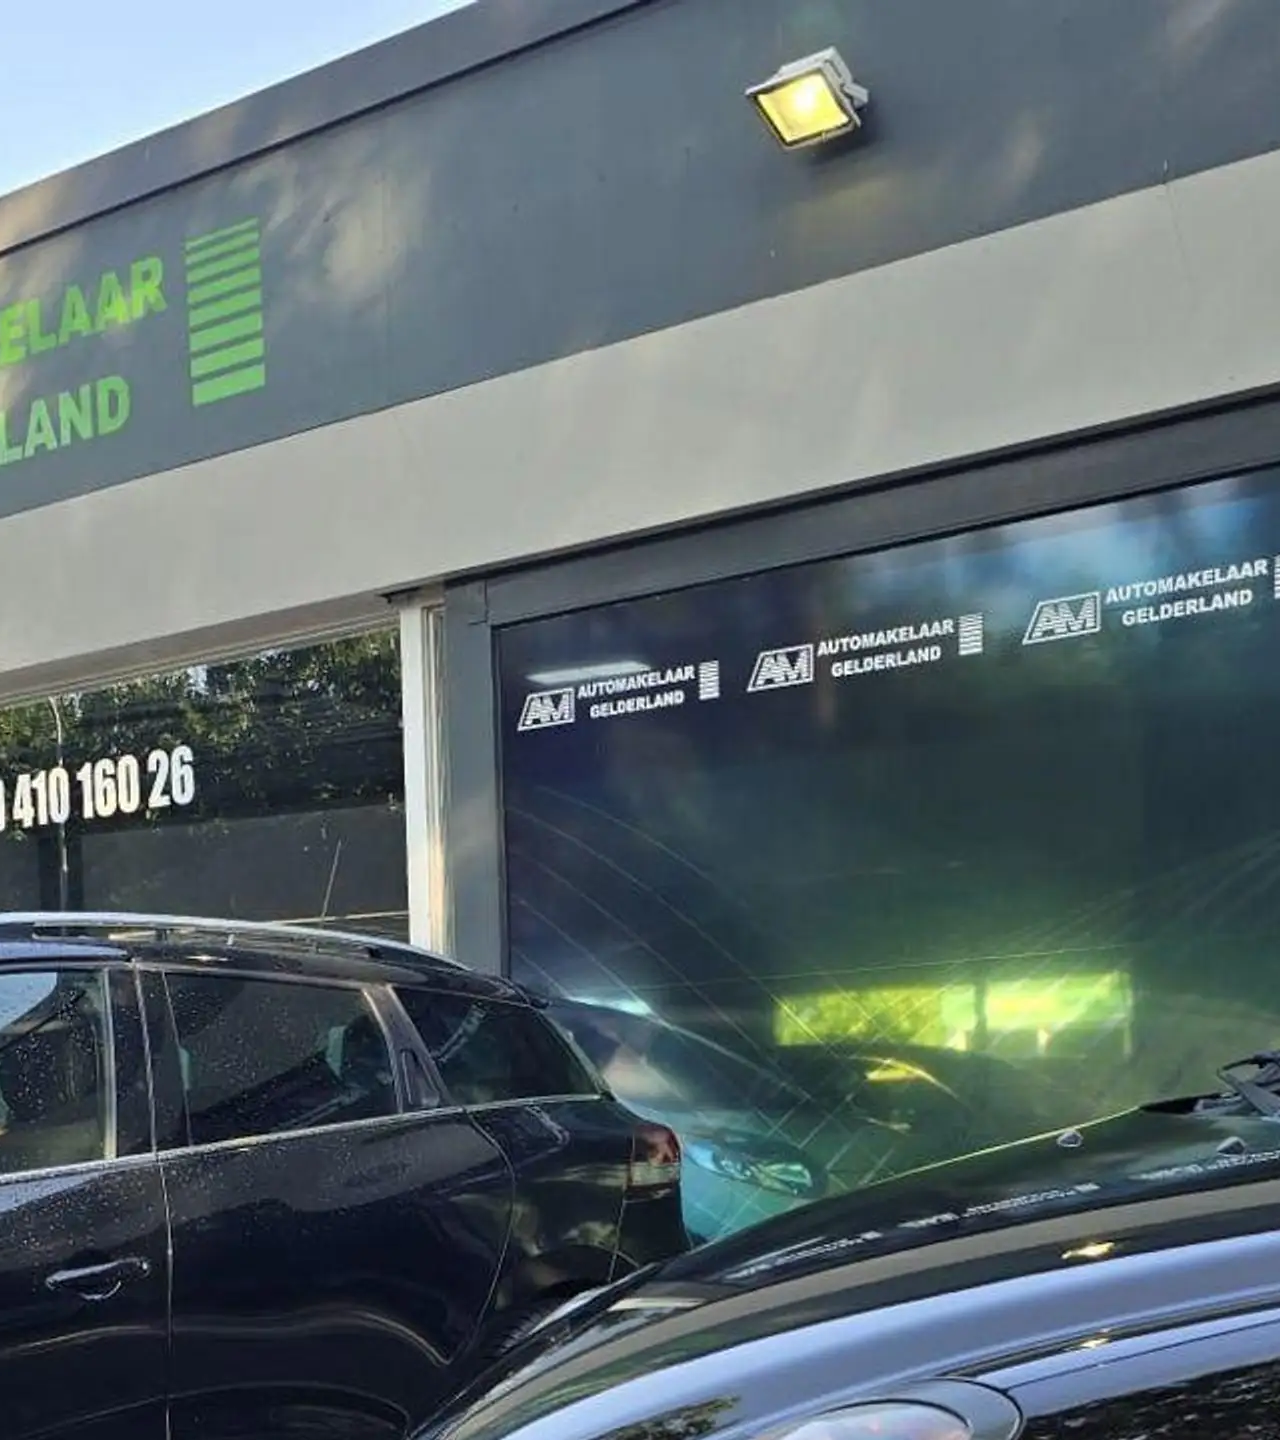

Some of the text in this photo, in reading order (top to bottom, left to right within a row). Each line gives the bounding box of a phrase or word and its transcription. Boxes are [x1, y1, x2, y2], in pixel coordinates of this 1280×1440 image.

[1105, 558, 1269, 604] AUTOMAKELAAR
[1122, 588, 1254, 628] GELDERLAND
[816, 618, 955, 656] AUTOMAKELAAR
[830, 644, 942, 679] GELDERLAND
[577, 664, 696, 700] AUTOMAKELAAR
[589, 690, 685, 720] GELDERLAND
[13, 766, 69, 828] 410
[76, 755, 141, 820] 160
[146, 745, 195, 808] 26
